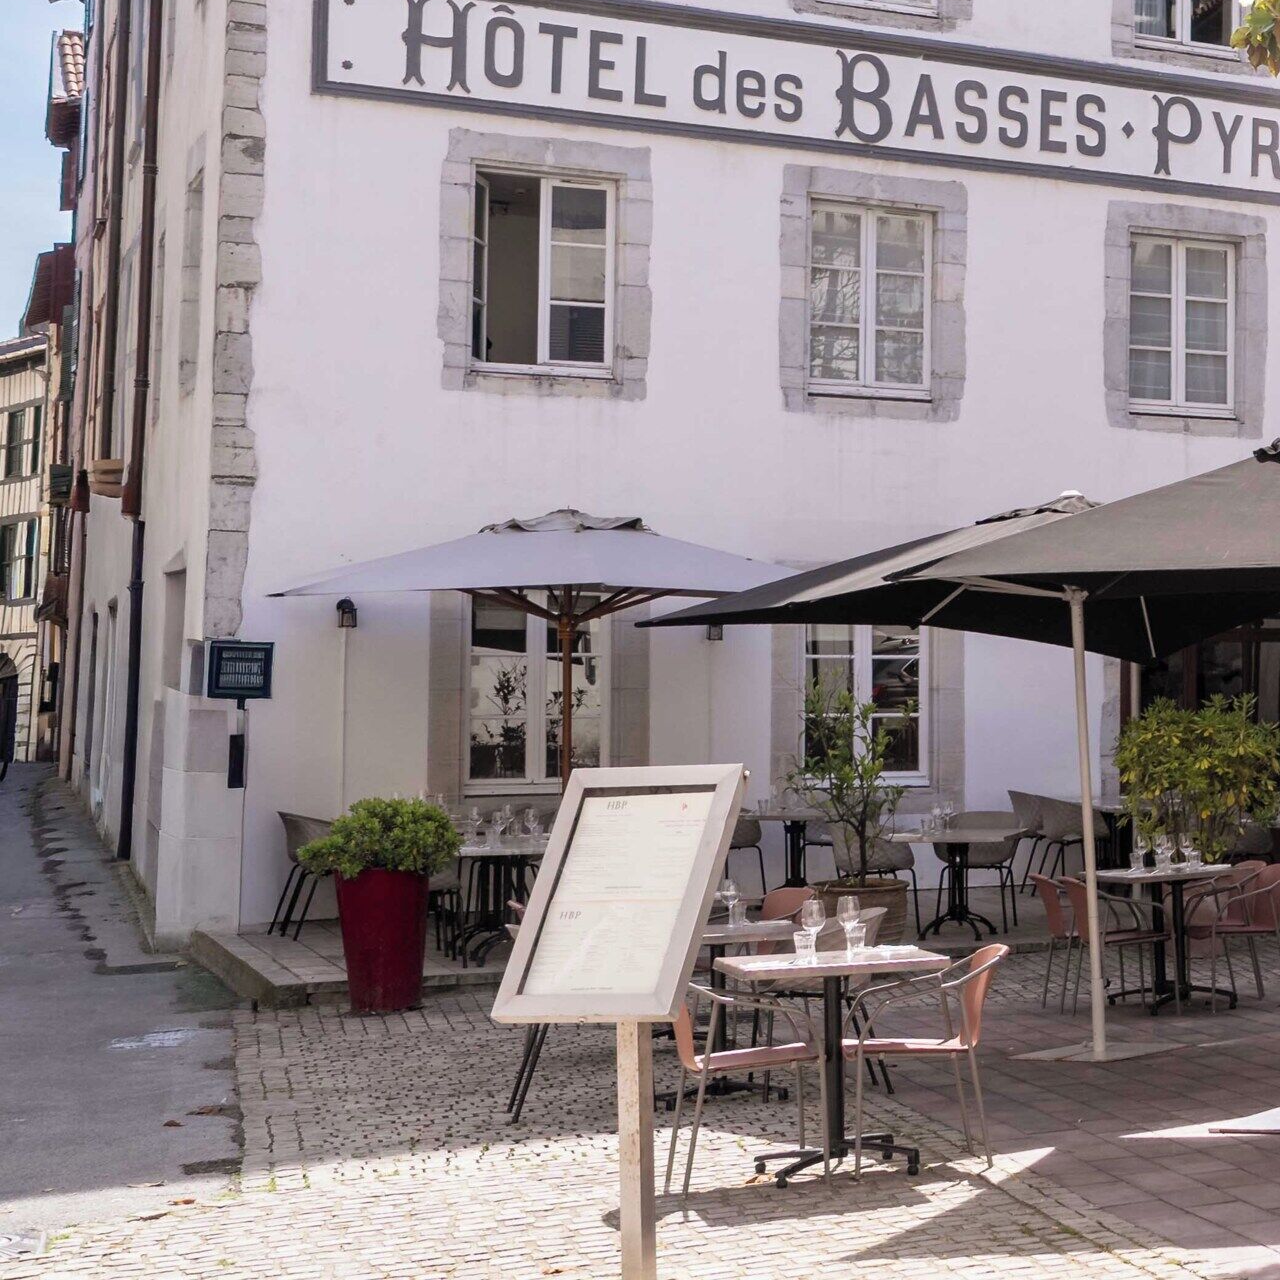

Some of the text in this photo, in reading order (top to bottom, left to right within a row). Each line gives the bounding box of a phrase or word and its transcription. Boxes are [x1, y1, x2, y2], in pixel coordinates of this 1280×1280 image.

[692, 50, 803, 123] des
[834, 49, 1107, 158] BASSES
[606, 800, 629, 810] HBP
[559, 911, 582, 920] HBP
